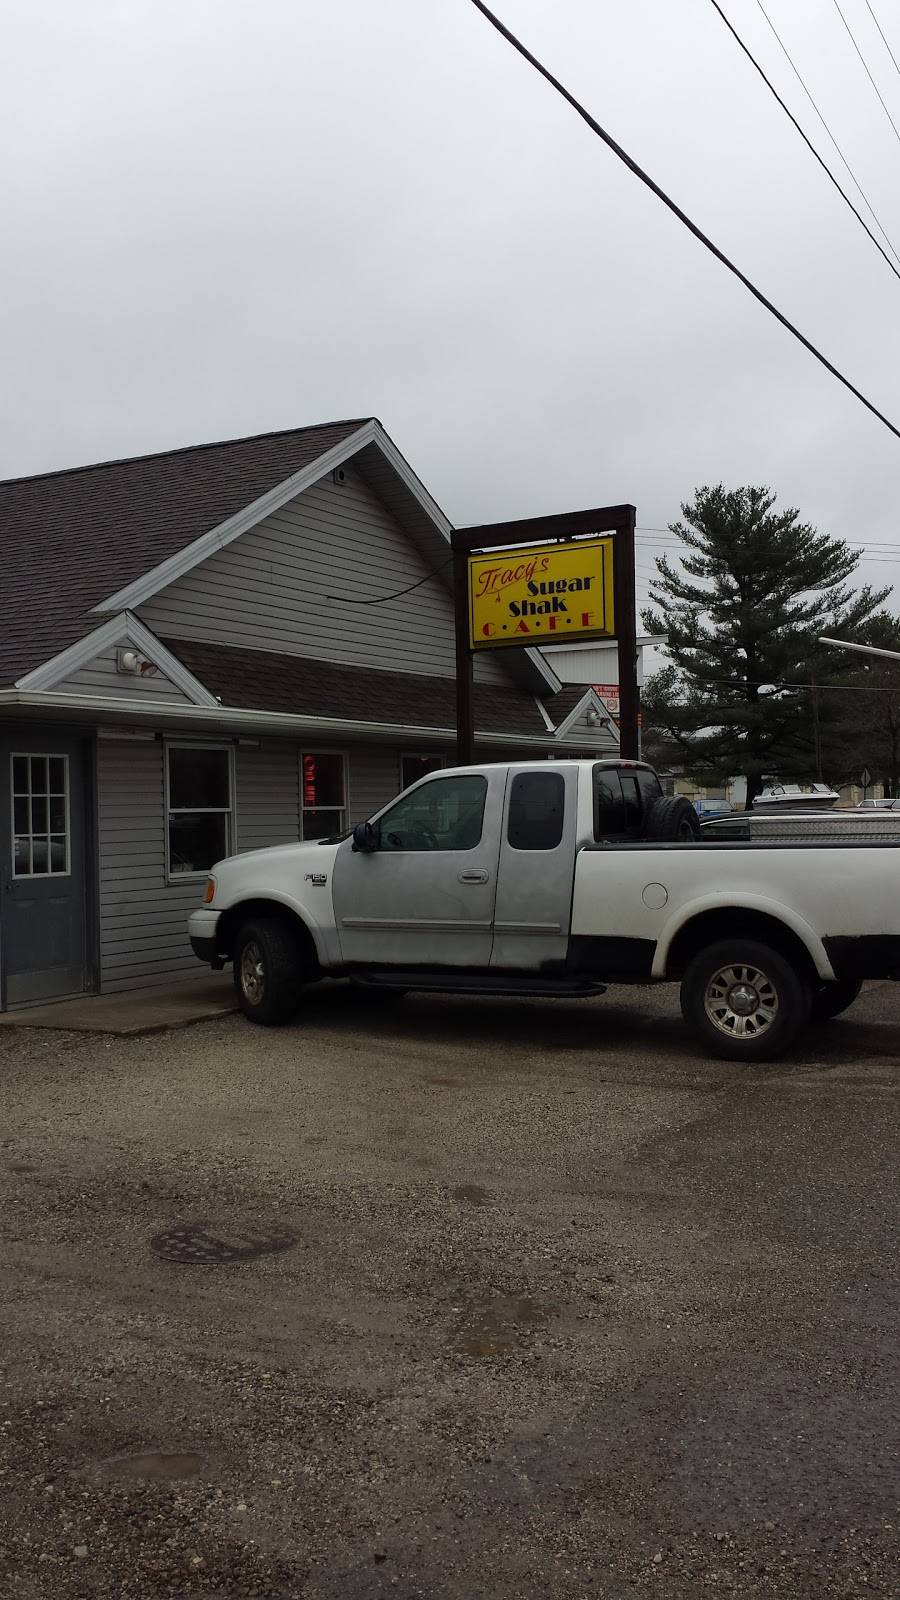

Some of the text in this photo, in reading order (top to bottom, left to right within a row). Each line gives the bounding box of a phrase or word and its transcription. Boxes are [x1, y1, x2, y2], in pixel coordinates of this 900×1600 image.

[475, 556, 549, 598] Tracy's
[527, 576, 595, 596] Sugar
[509, 597, 568, 617] Shak
